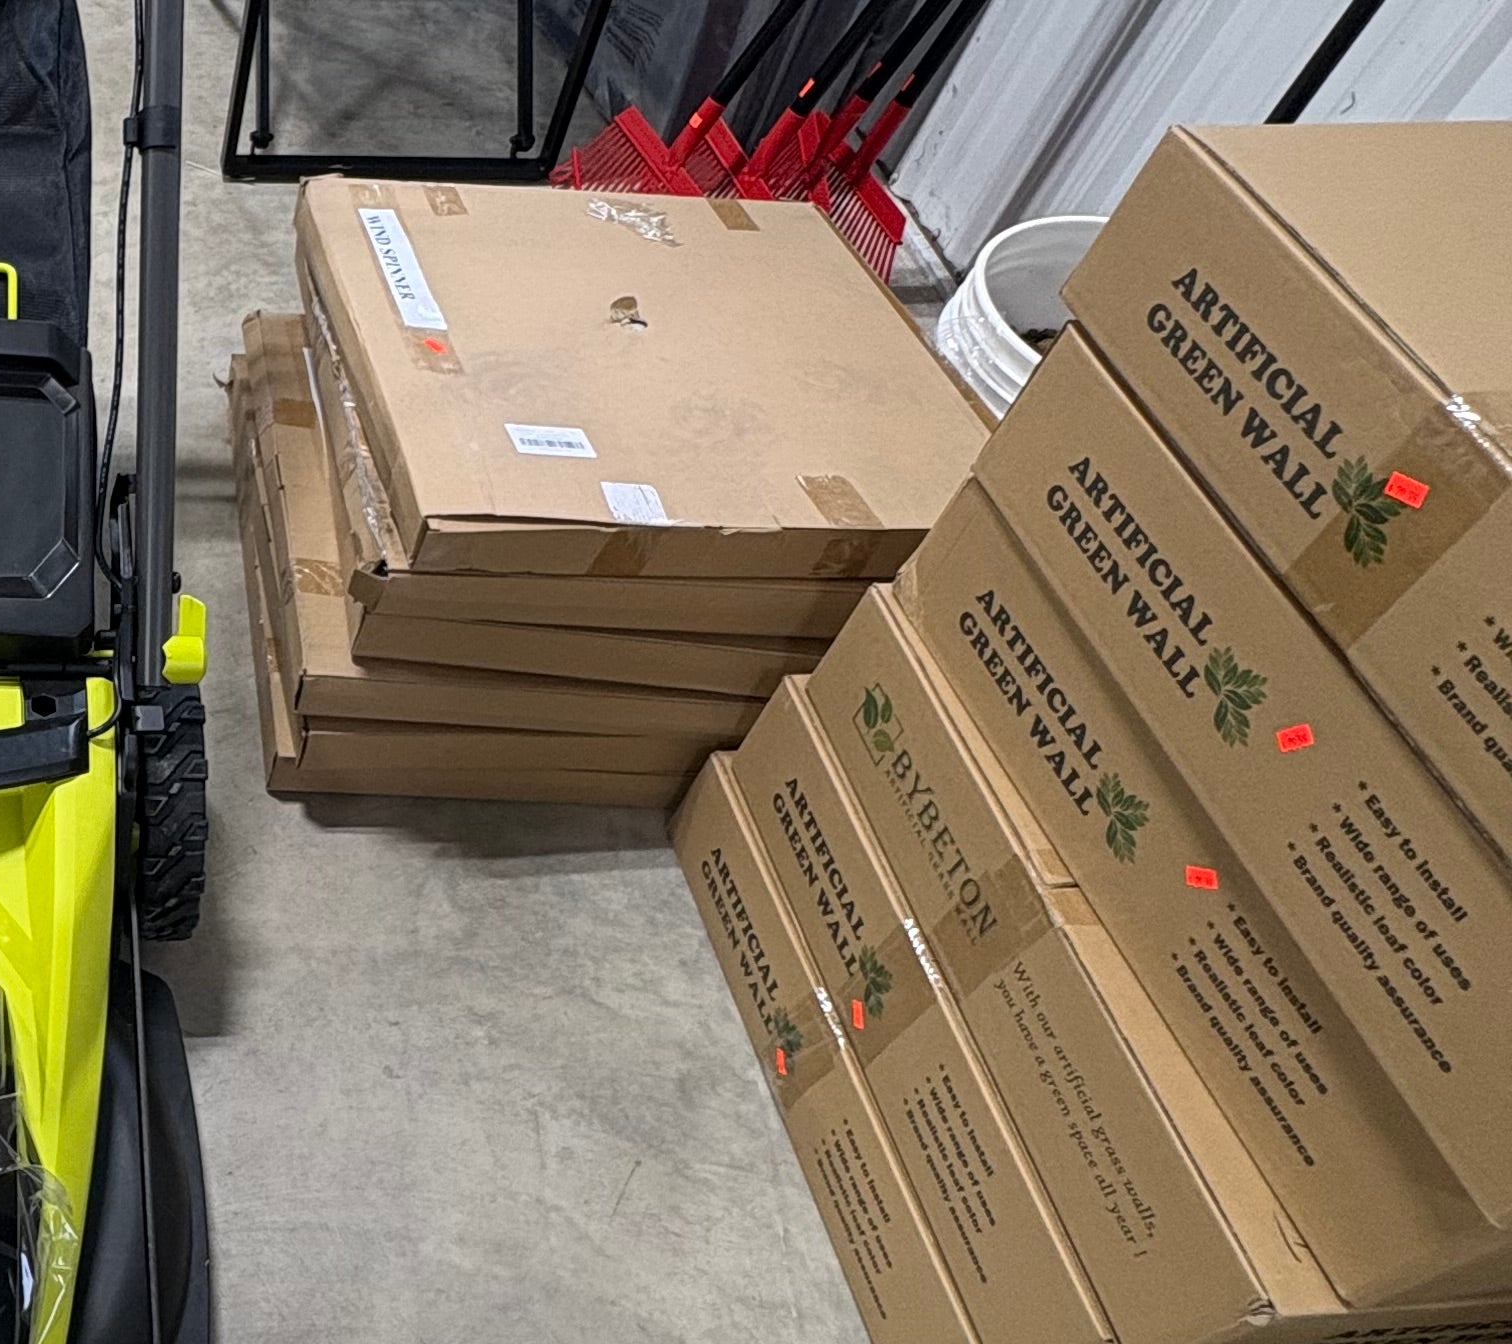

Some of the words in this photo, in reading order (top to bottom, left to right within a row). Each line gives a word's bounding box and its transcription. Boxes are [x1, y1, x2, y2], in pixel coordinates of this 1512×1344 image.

[366, 215, 392, 246] WIND
[380, 247, 416, 301] SPINNER
[1147, 303, 1244, 416] GREEN
[1240, 407, 1328, 520] WALL
[1171, 267, 1344, 459] ARTIFICIAL
[1046, 484, 1130, 595] GREEN
[1126, 589, 1201, 699] WALL
[1068, 457, 1218, 646] ARTIFICIAL
[959, 612, 1032, 717] GREEN
[1029, 714, 1094, 816] WALL
[975, 590, 1104, 770] ARTIFICIAL
[1437, 679, 1486, 736] Brand
[711, 847, 780, 1002] ARTIFICIAL
[772, 792, 819, 888] GREEN
[816, 887, 859, 977] WALL
[785, 777, 865, 941] ARTIFICIAL
[892, 749, 997, 937] BYBETON
[1315, 836, 1375, 916] Realistic
[1373, 916, 1408, 954] leaf
[1402, 957, 1444, 1005] color
[1339, 816, 1375, 864] Wide
[1373, 864, 1416, 918] range
[1415, 920, 1439, 941] of
[1432, 943, 1471, 992] uses
[1365, 793, 1401, 839] Easy
[1398, 838, 1417, 861] to
[1415, 859, 1468, 923] install
[701, 860, 740, 951] GREEN
[740, 951, 776, 1035] WALL
[993, 978, 1016, 1009] you
[1193, 949, 1246, 1024] Realistic
[1244, 1023, 1275, 1059] leaf
[1270, 1060, 1306, 1107] color
[1213, 932, 1244, 978] Wide
[1242, 978, 1280, 1028] range
[1279, 1029, 1300, 1049] of
[1295, 1051, 1328, 1096] uses
[1233, 915, 1265, 957] Easy
[1263, 956, 1278, 978] to
[1277, 977, 1324, 1035] install
[1293, 854, 1336, 908] Brand
[1331, 909, 1380, 971] quality
[1377, 974, 1452, 1074] assurance
[942, 1075, 961, 1110] Easy
[959, 1110, 969, 1128] to
[1013, 961, 1039, 1009] With
[1036, 1012, 1057, 1041] our
[1053, 1044, 1103, 1123] artificial
[1091, 1123, 1126, 1175] grass
[1014, 1009, 1038, 1051] have
[1034, 1055, 1046, 1067] a
[1039, 1069, 1071, 1116] green
[1176, 964, 1213, 1014] Brand
[1209, 1015, 1252, 1073] quality
[1250, 1075, 1315, 1167] assurance
[929, 1086, 948, 1125] Wide
[947, 1125, 969, 1169] range
[967, 1170, 980, 1187] of
[976, 1190, 996, 1227] uses
[1067, 1121, 1098, 1170] space
[1094, 1172, 1117, 1199] all
[1106, 1202, 1137, 1245] year
